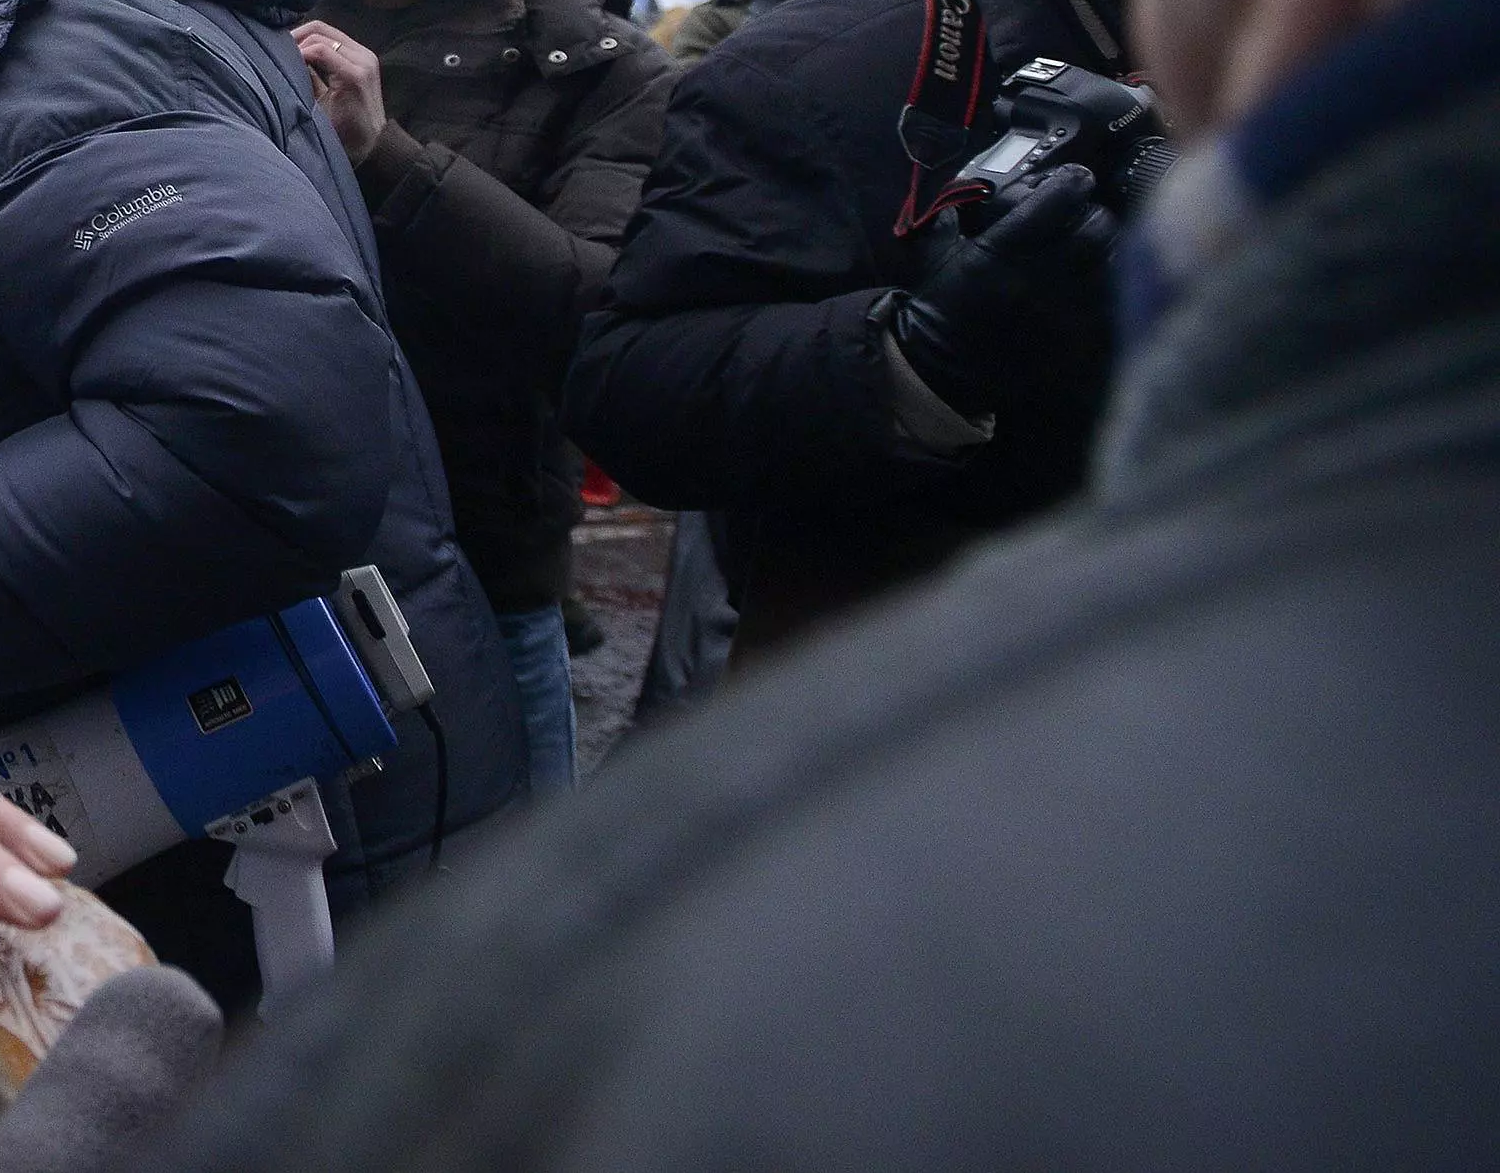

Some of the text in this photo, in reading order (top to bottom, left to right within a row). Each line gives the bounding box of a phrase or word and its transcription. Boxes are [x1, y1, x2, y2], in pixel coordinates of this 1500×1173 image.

[1108, 105, 1142, 132] Canon
[91, 184, 178, 231] Columbia
[142, 193, 183, 215] Company
